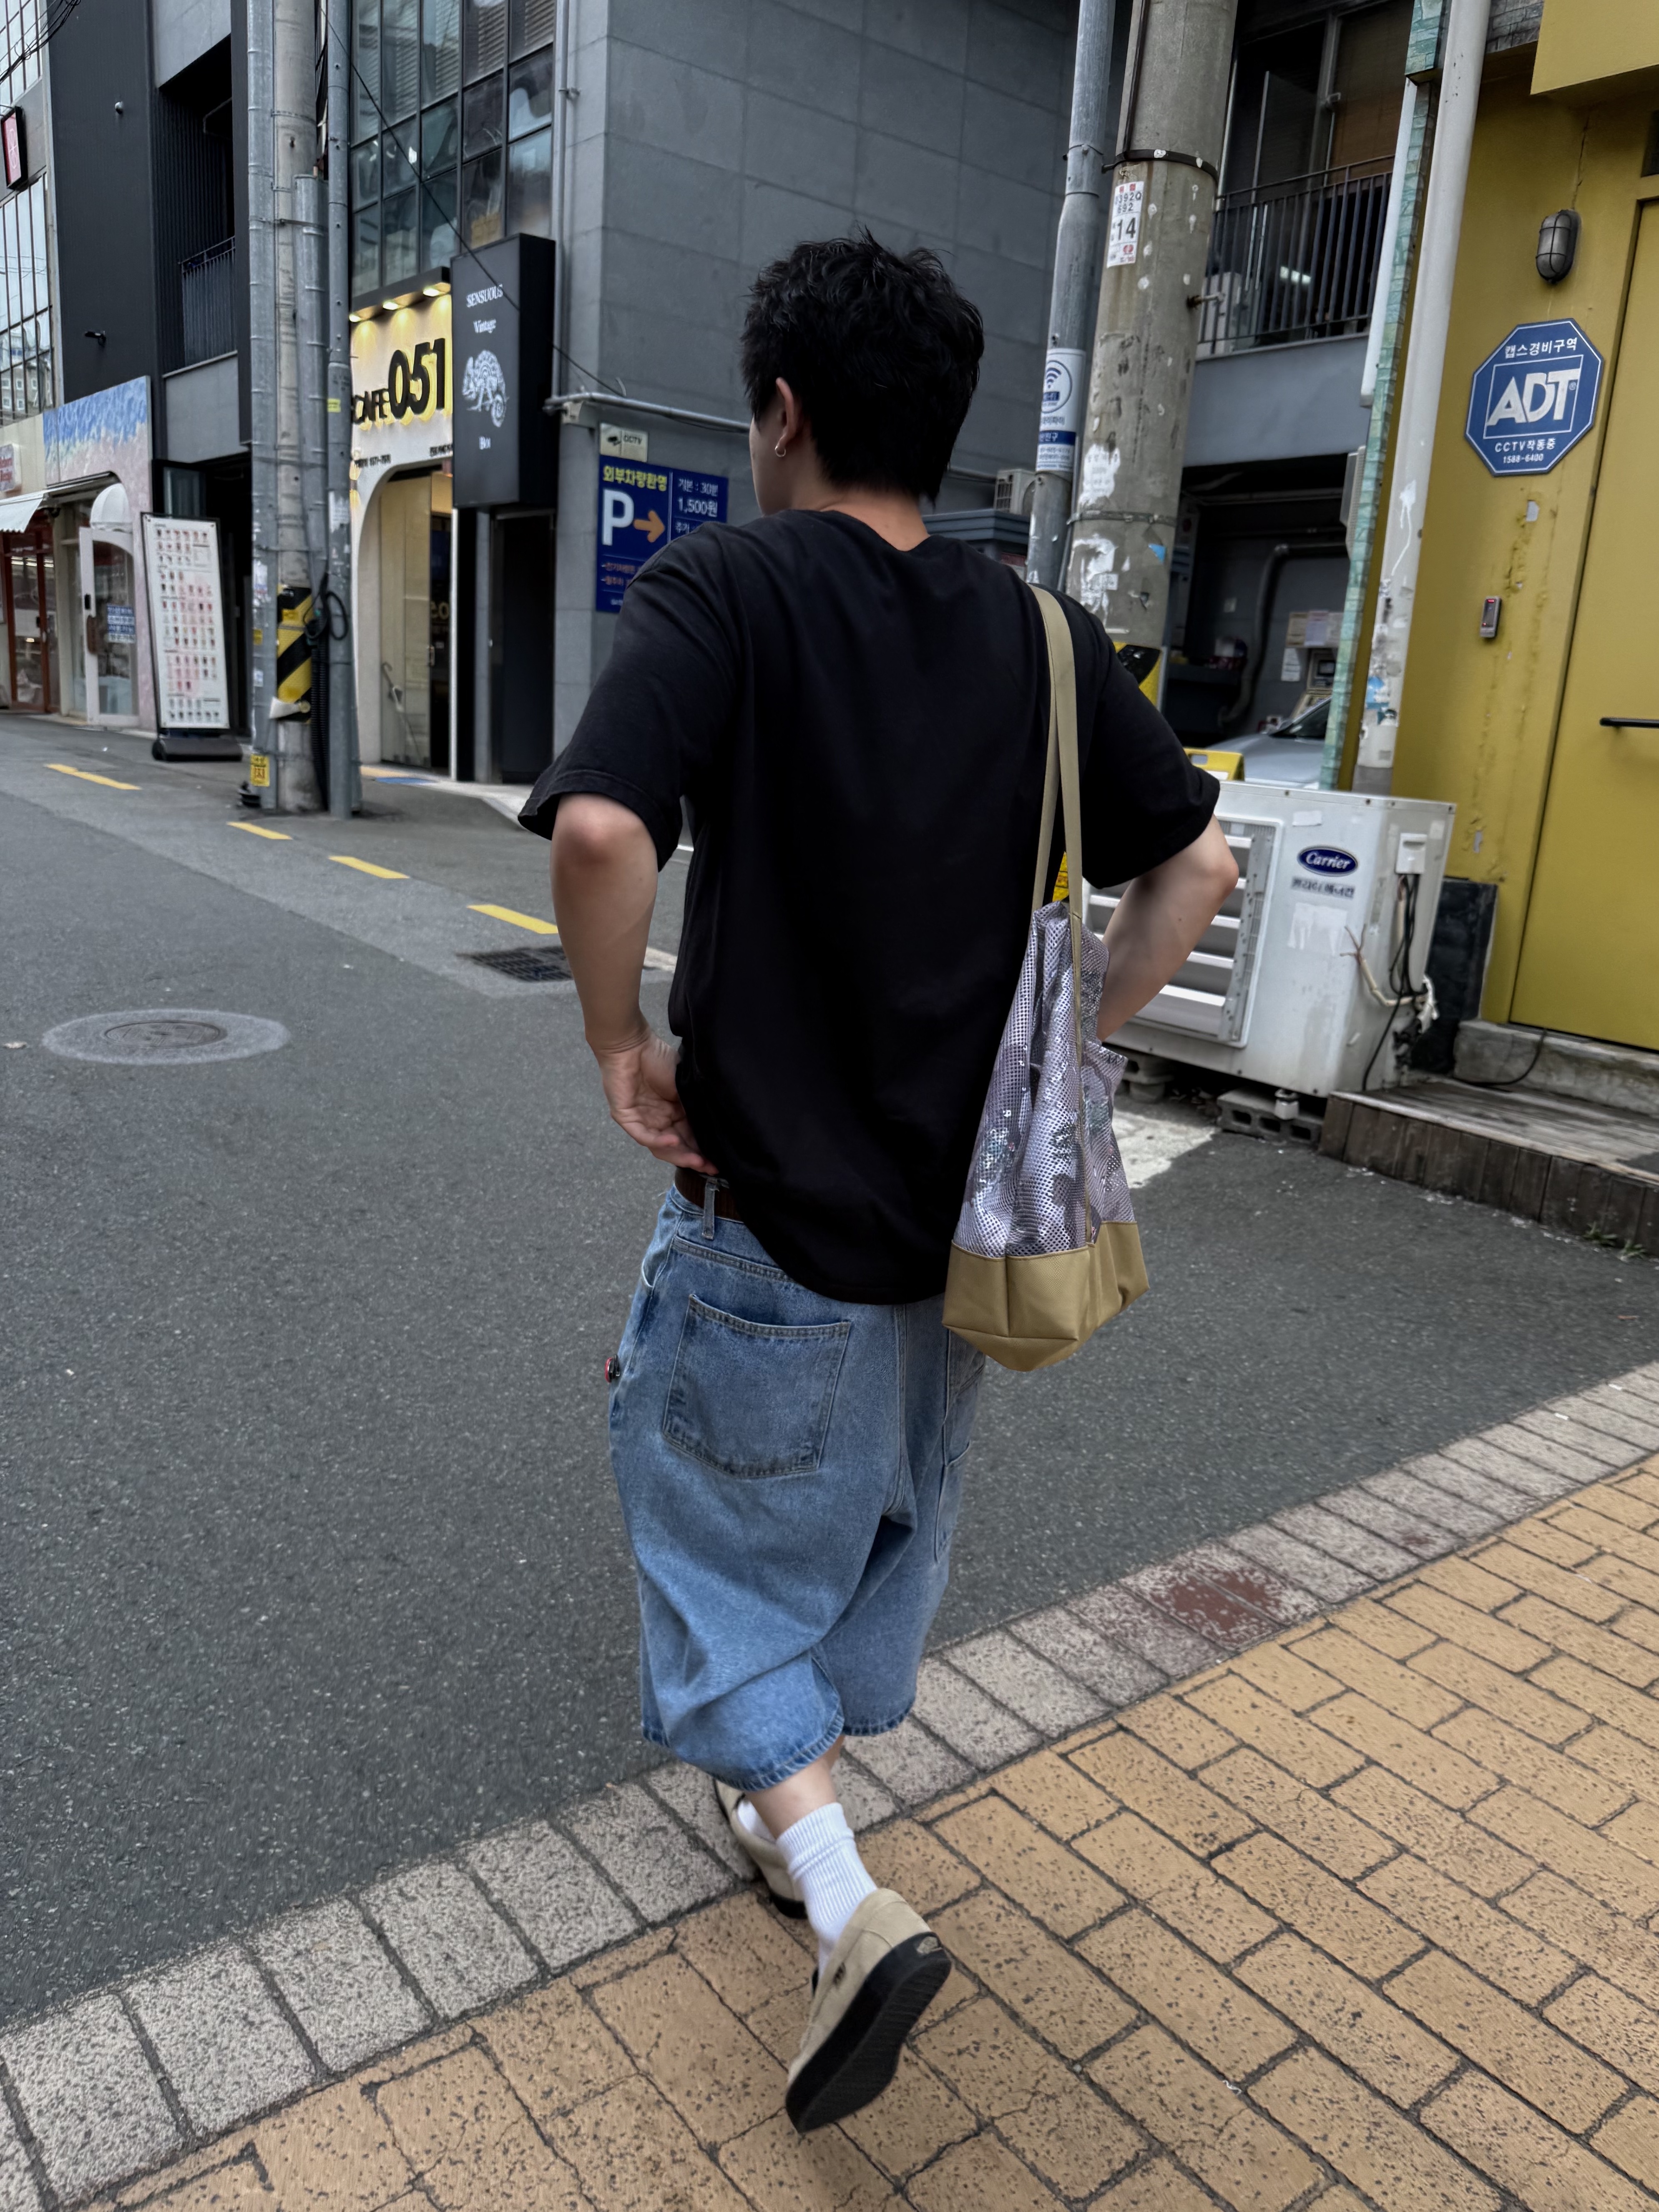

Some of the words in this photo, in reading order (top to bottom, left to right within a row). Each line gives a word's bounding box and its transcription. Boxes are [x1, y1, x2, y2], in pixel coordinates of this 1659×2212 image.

[1117, 218, 1136, 240] 14
[466, 284, 503, 307] SENSUOUS
[473, 319, 496, 333] Vintage
[1505, 337, 1577, 359] 캡스경비구역
[352, 388, 390, 424] CAFE
[388, 338, 445, 419] 051
[1486, 368, 1581, 426] ADT
[623, 434, 642, 445] CCTV
[1503, 453, 1543, 464] 1588-6400
[603, 465, 667, 492] 외부차량환영
[678, 478, 694, 493] 기본
[602, 489, 634, 545] P
[678, 496, 718, 518] 1,500원
[1305, 851, 1350, 869] Carrier
